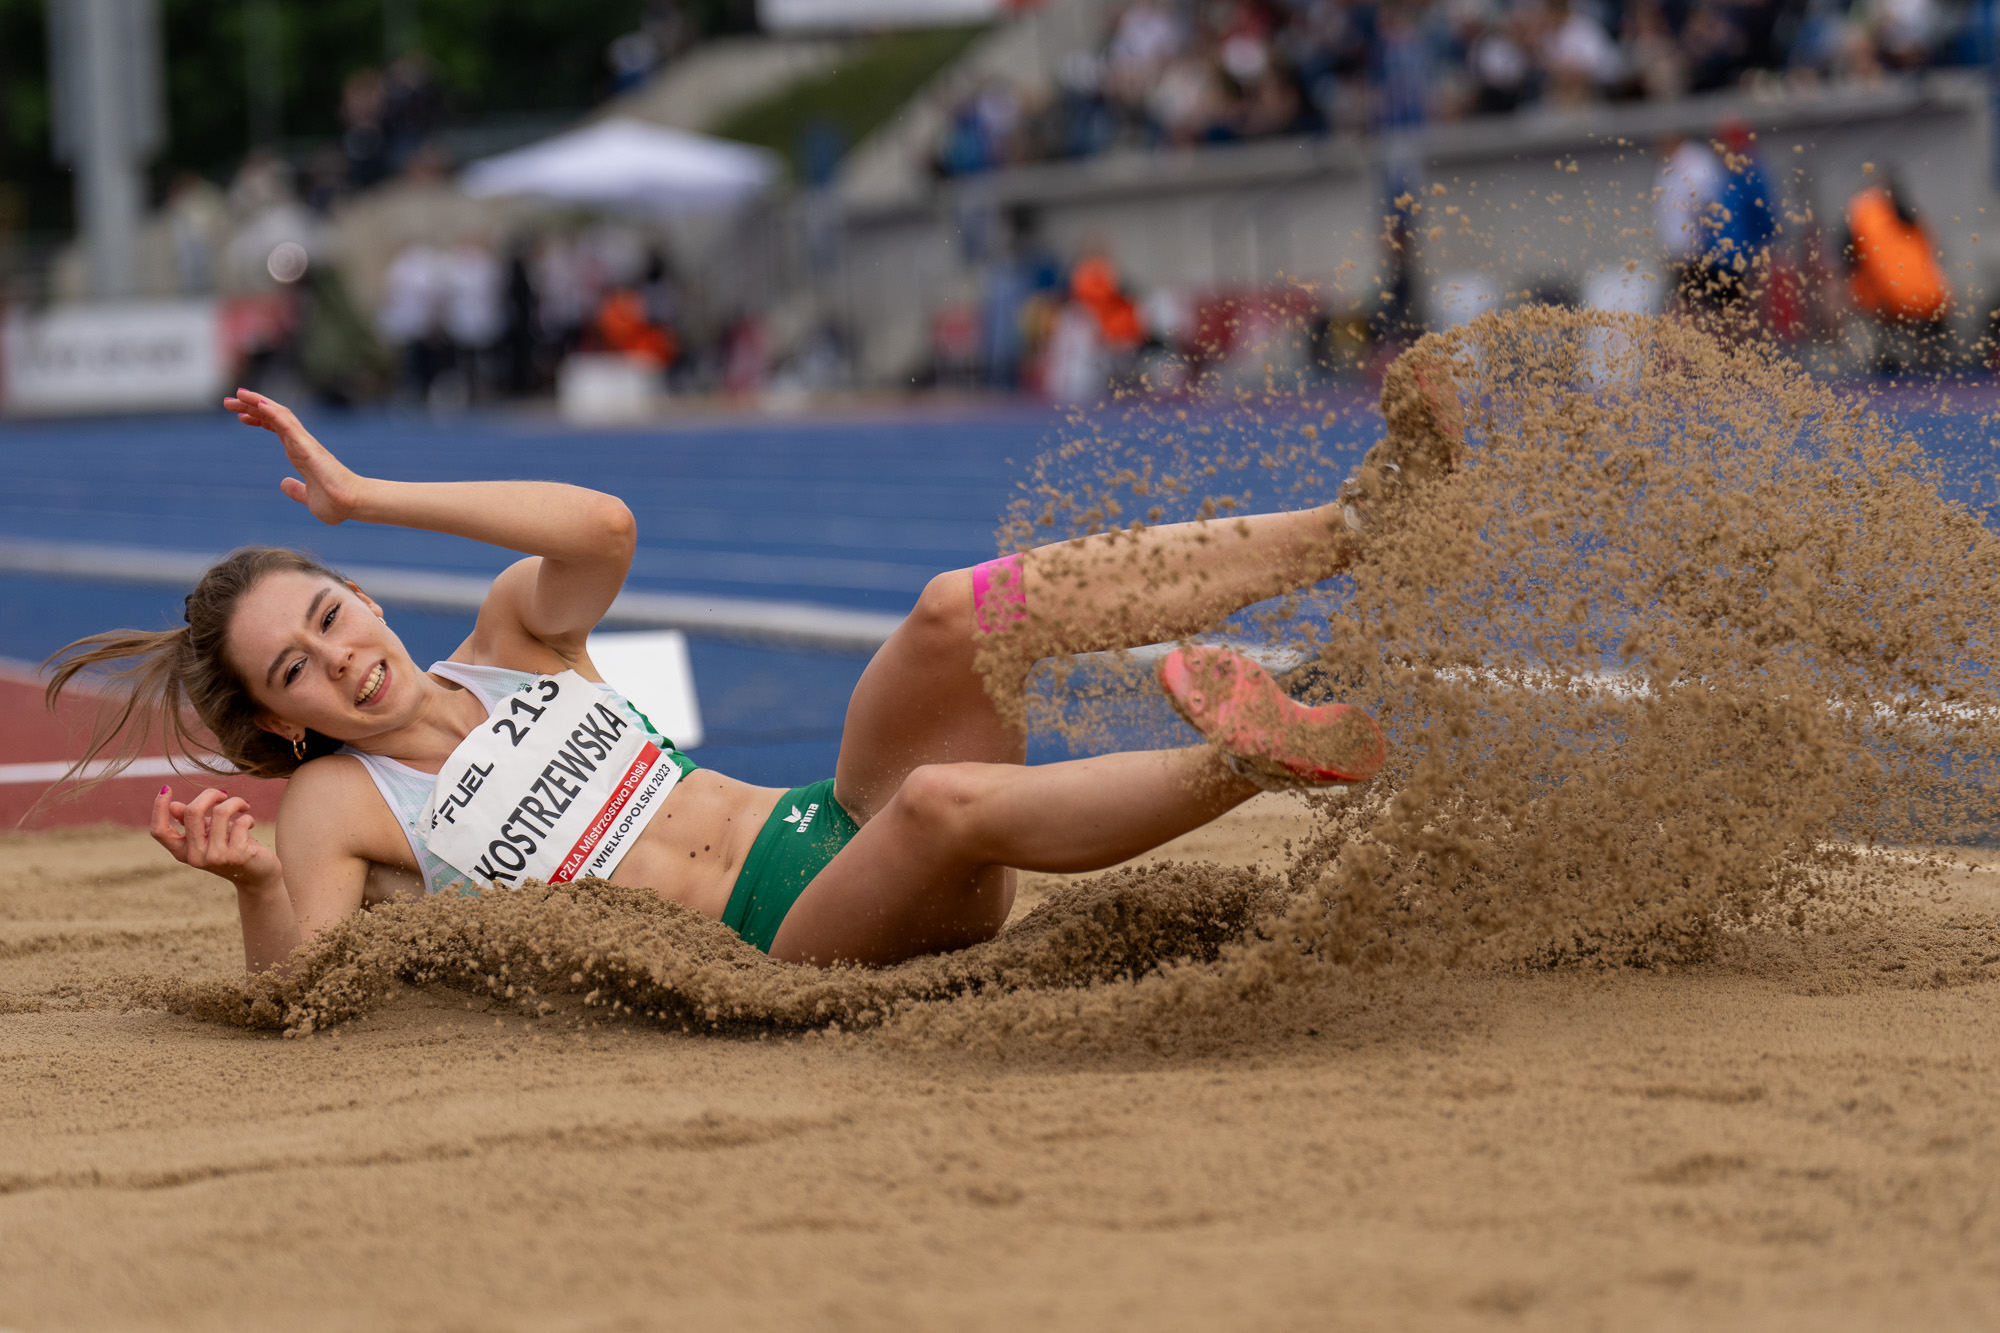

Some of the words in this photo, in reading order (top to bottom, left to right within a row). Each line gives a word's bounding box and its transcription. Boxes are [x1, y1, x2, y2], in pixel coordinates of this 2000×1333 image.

[473, 702, 628, 888] KOSTRZEWSKA
[558, 853, 584, 880] PZLA
[578, 788, 630, 853] Mistrzostwa
[623, 761, 649, 789] Polski
[592, 784, 658, 869] WIELKOPOLSKI
[651, 763, 671, 787] 2023
[796, 803, 819, 833] erima
